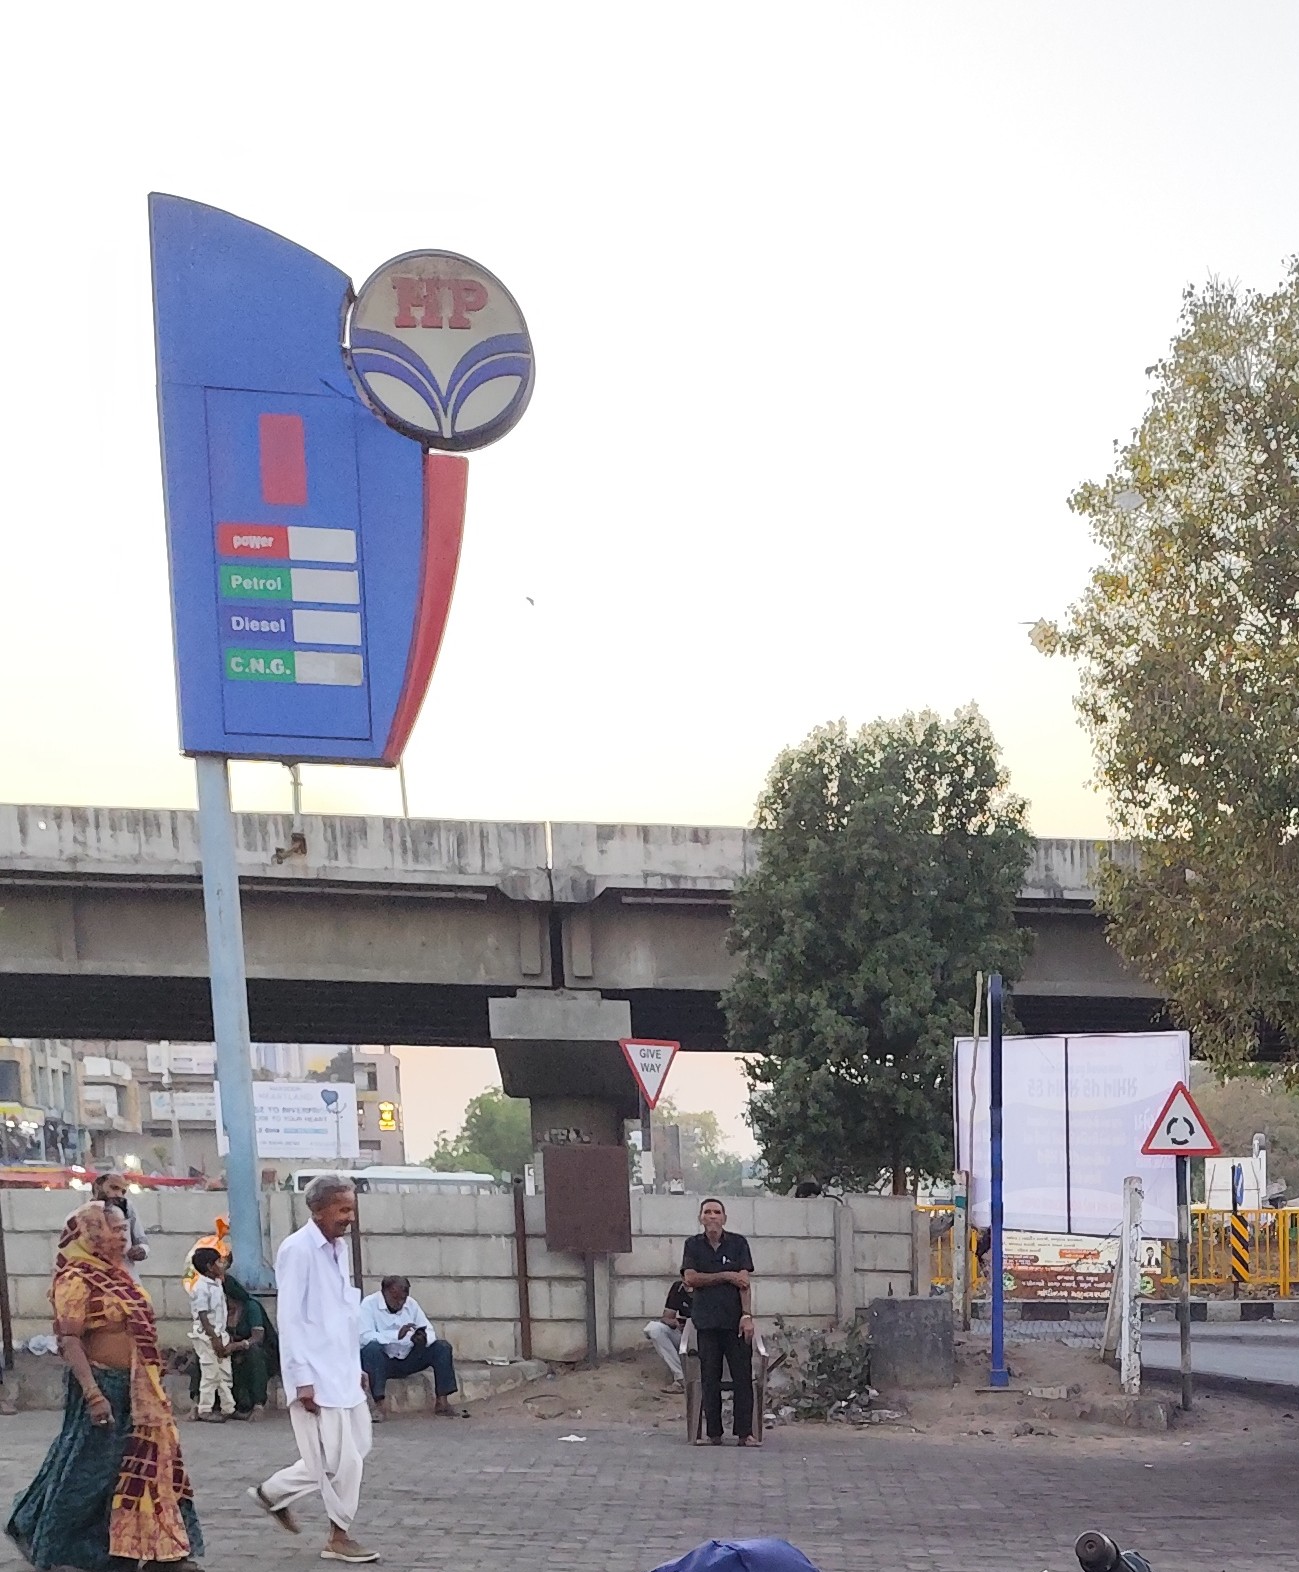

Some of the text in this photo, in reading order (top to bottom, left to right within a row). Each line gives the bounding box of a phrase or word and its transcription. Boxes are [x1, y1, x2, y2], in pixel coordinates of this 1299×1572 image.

[391, 276, 488, 329] HP
[230, 574, 282, 591] Petrol
[230, 616, 286, 633] Diesel
[230, 656, 291, 675] C.N.G.
[639, 1048, 662, 1060] GIVE
[640, 1062, 662, 1073] WAY
